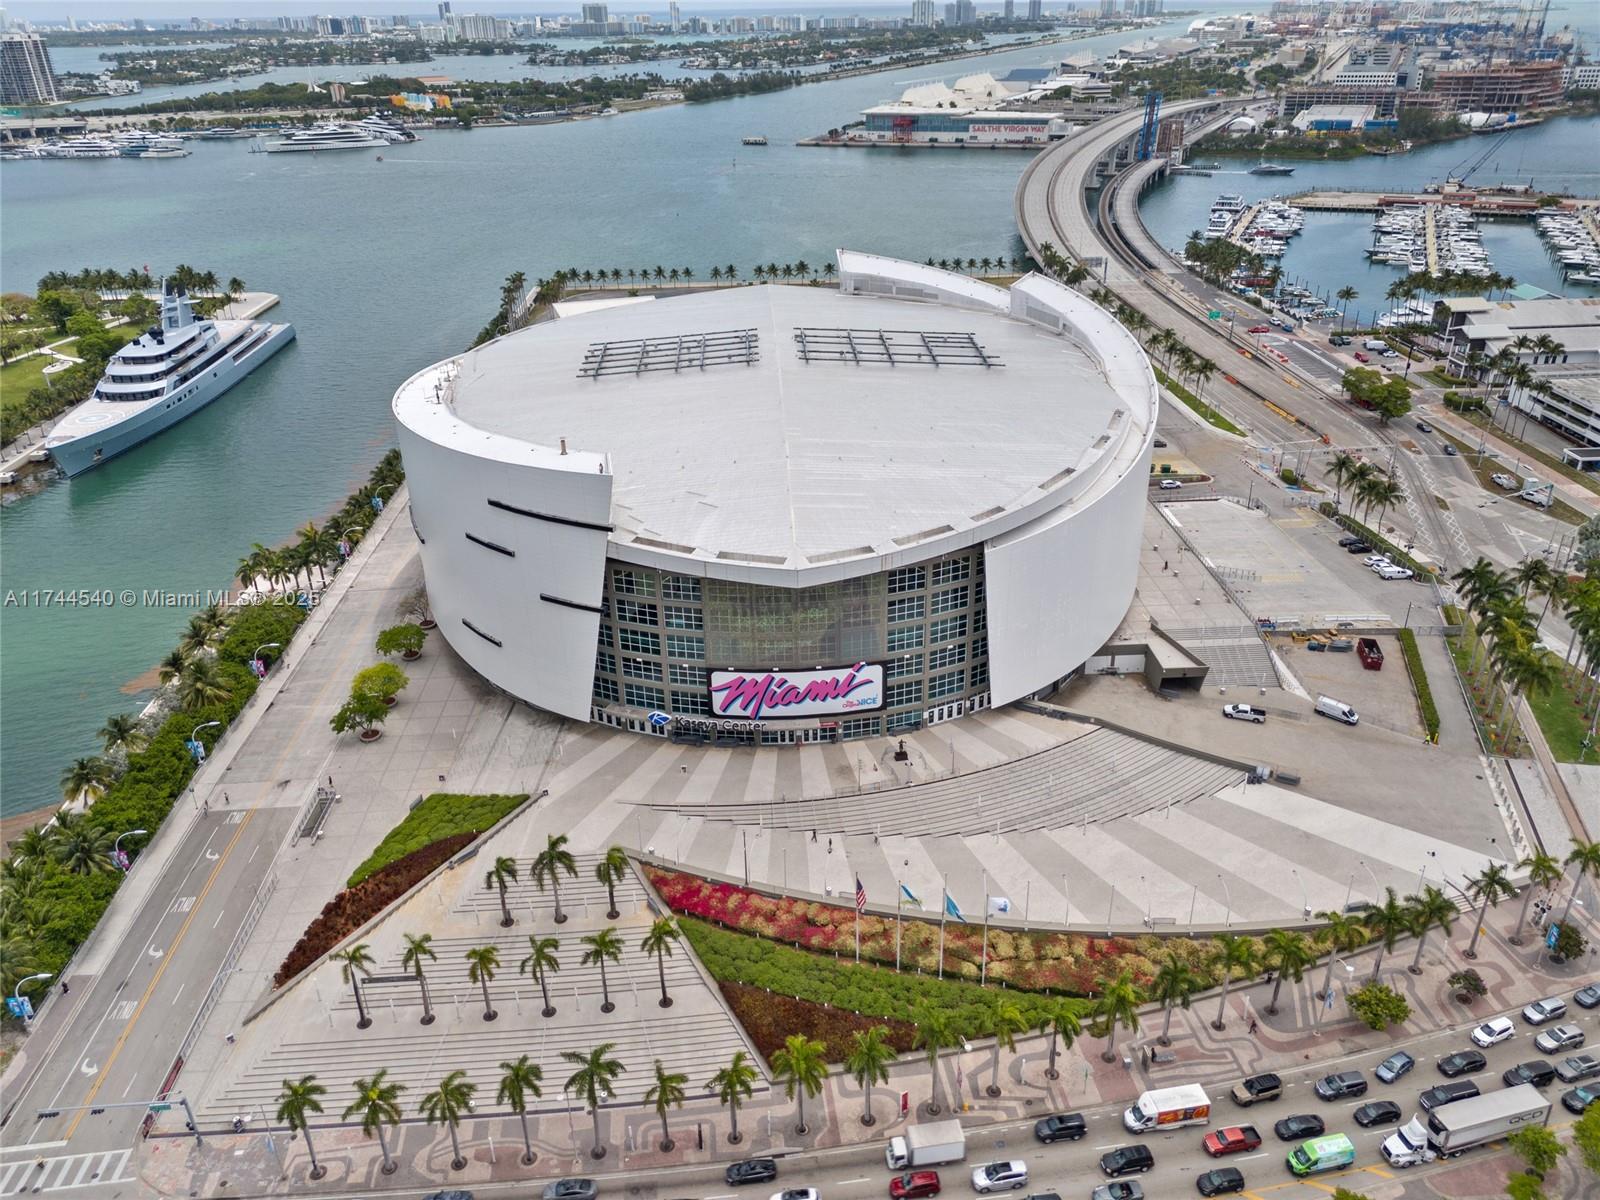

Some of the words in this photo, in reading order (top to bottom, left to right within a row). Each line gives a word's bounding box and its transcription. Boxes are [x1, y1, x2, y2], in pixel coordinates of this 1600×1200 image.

[972, 125, 987, 133] SAIL
[988, 125, 1001, 133] THE
[1003, 125, 1029, 133] VIRGIN
[1031, 125, 1046, 133] WAY
[709, 660, 874, 720] Miami
[675, 715, 718, 731] Kaseya
[722, 719, 768, 731] Center
